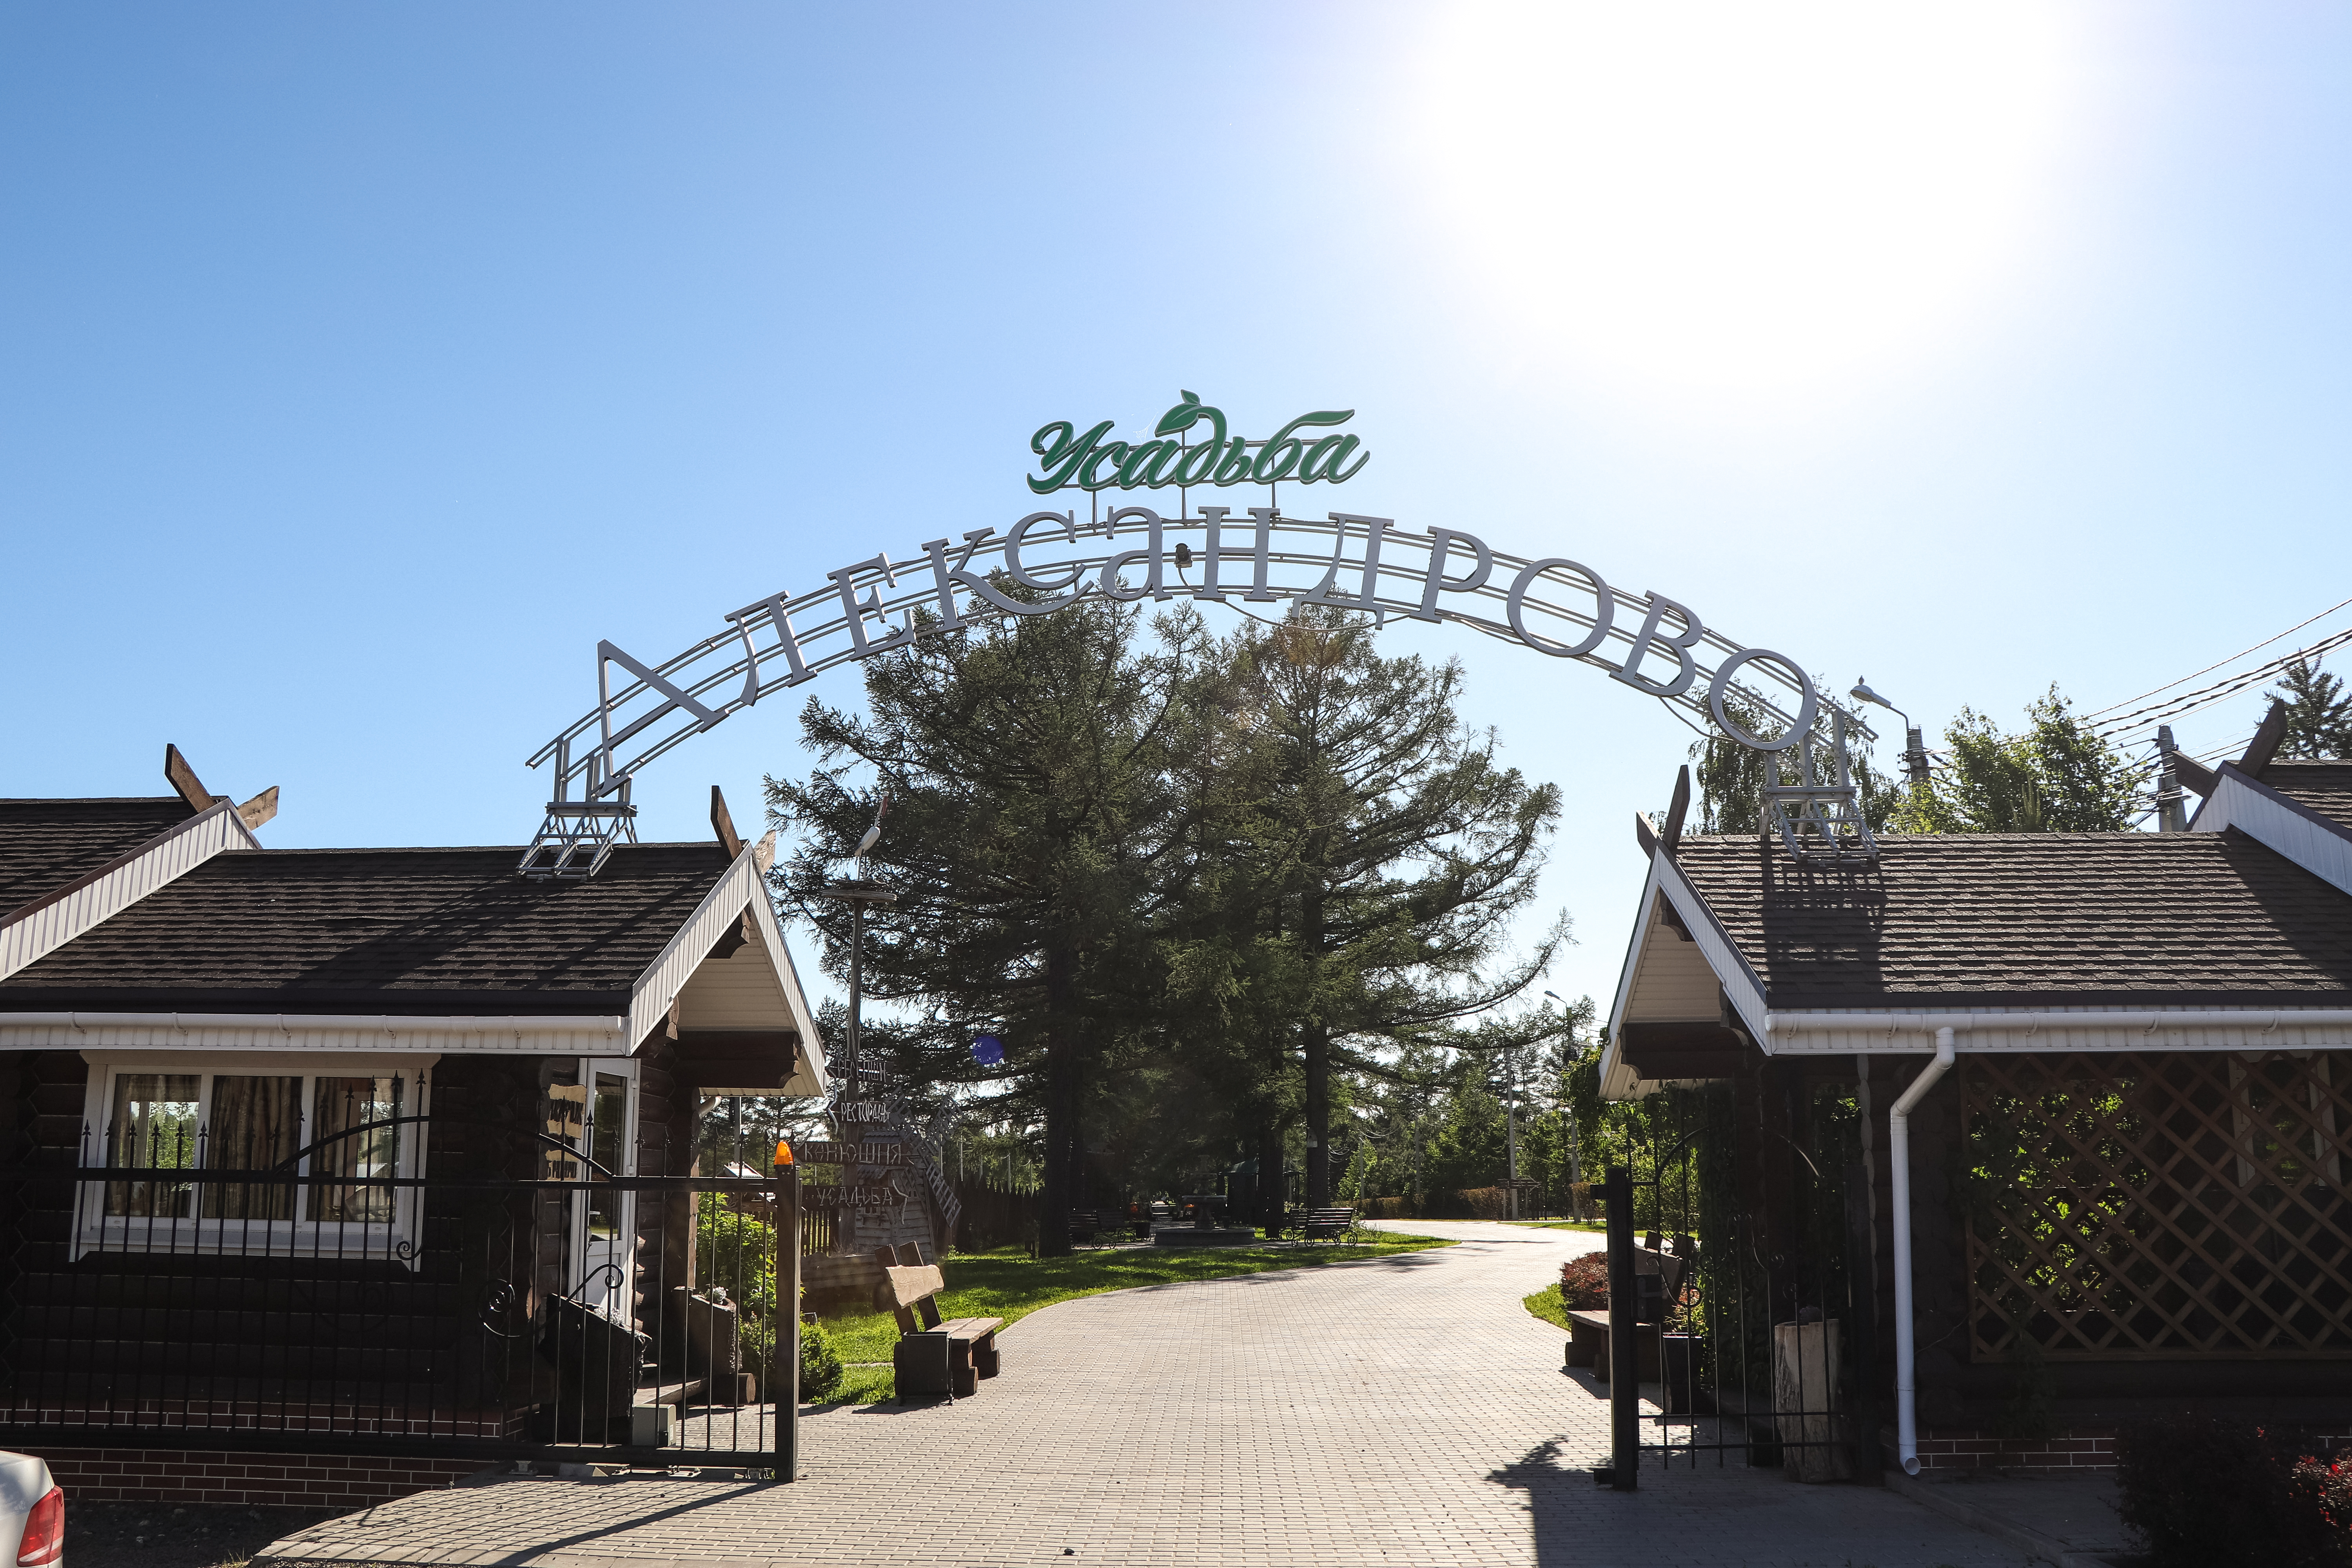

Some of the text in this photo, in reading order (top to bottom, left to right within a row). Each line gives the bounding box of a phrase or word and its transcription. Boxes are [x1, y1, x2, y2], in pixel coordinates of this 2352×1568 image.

[1027, 390, 1370, 494] Усадьба
[805, 1143, 901, 1165] КОНЮШНЯ
[816, 1186, 893, 1207] УСАДЬБА
